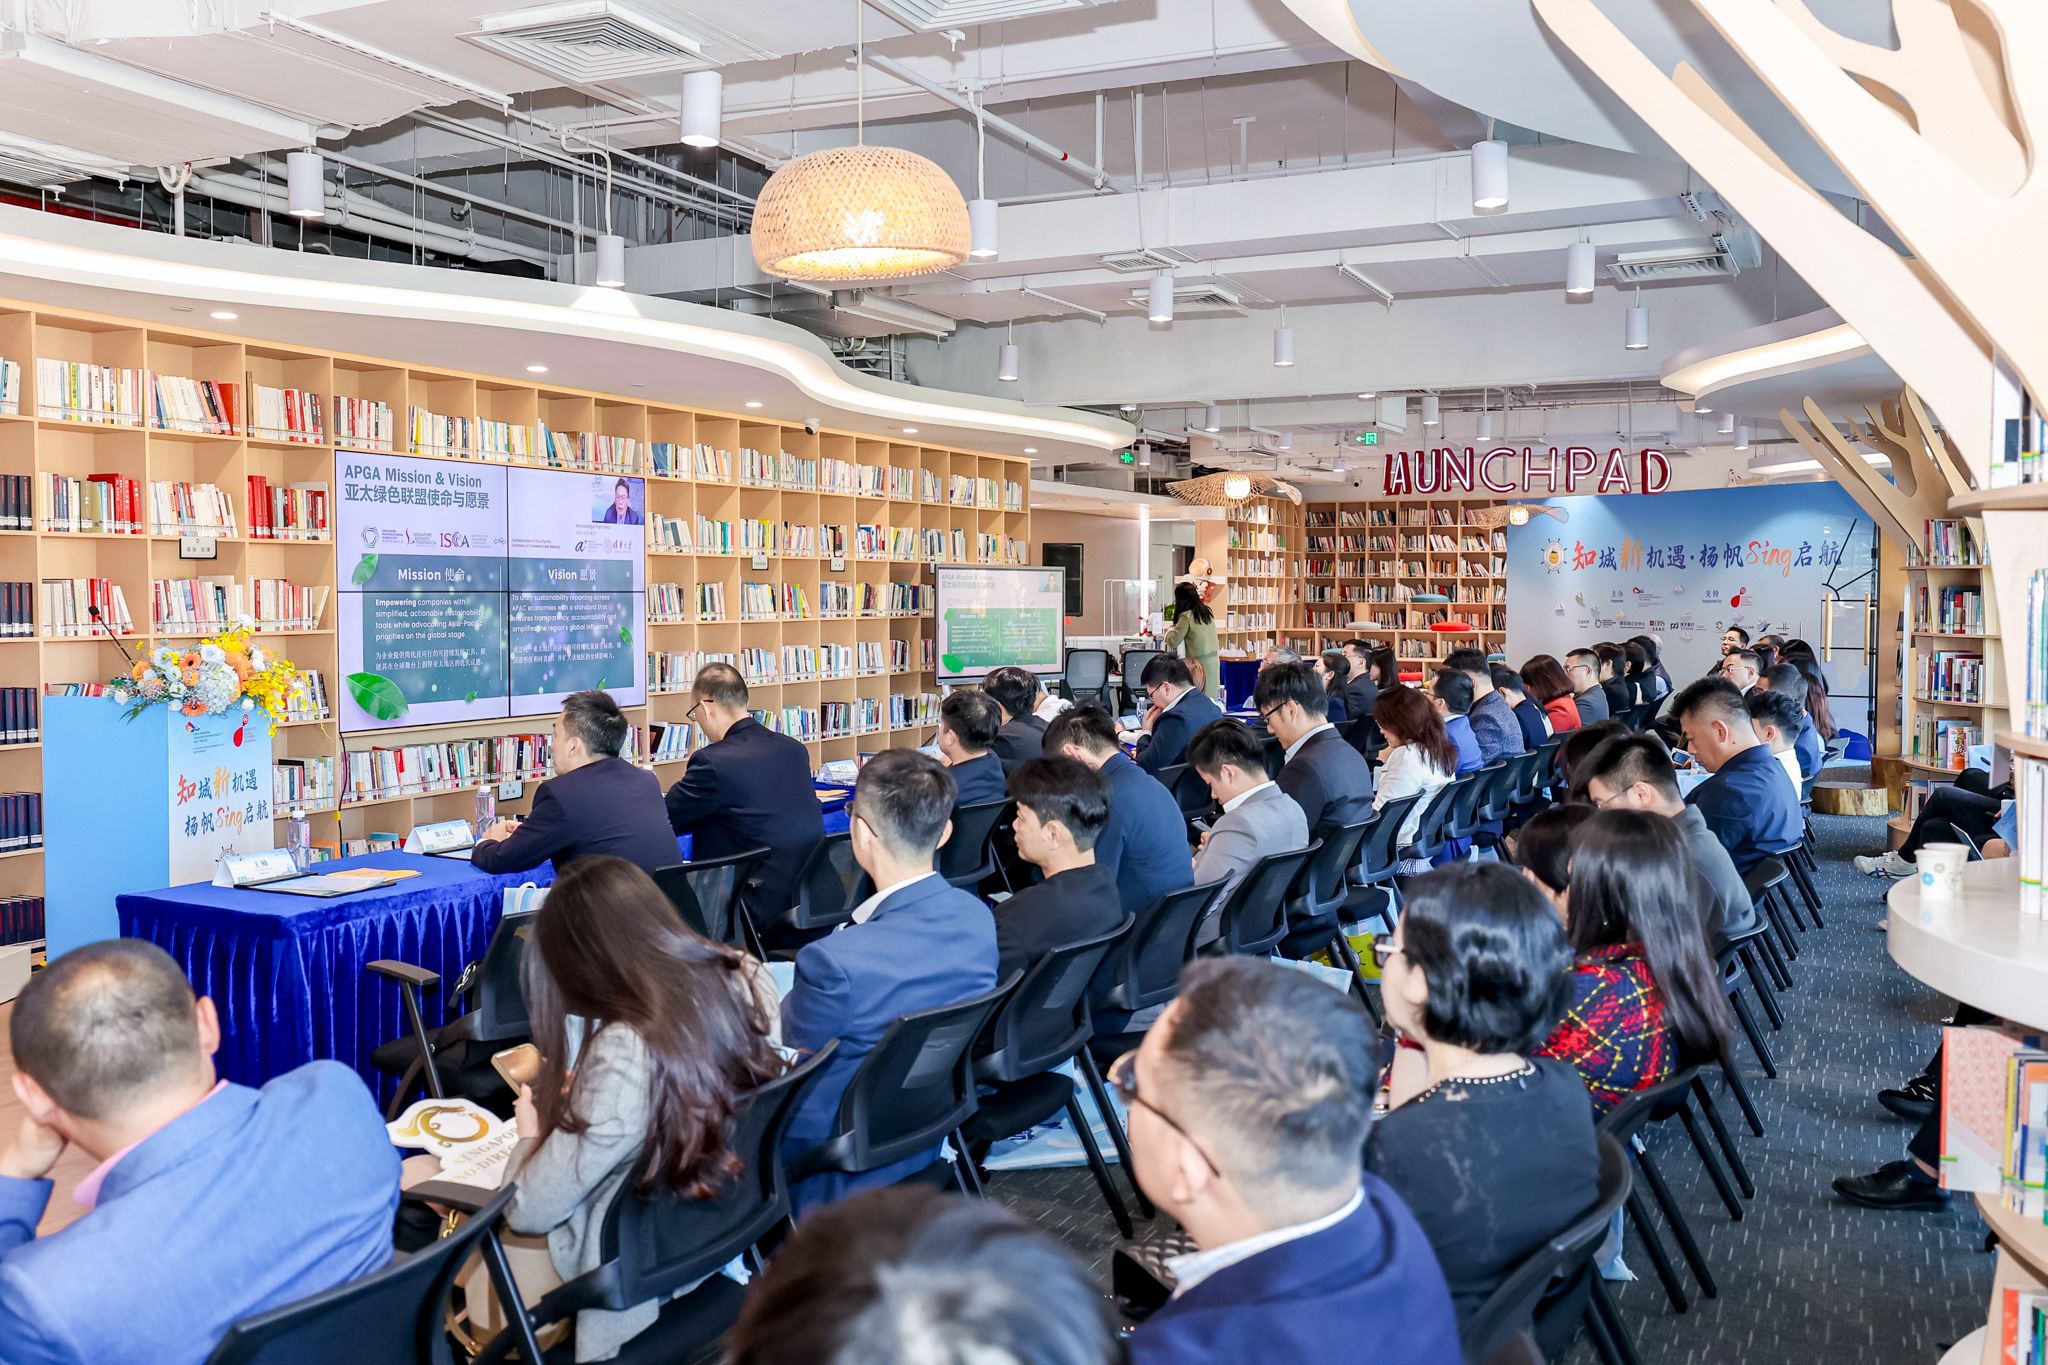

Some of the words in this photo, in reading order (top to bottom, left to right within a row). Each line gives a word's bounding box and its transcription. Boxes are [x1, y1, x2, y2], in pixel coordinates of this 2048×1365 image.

[344, 464, 381, 481] APGA
[385, 467, 432, 484] Mission
[435, 471, 445, 486] &
[448, 472, 482, 488] Vision
[344, 483, 490, 509] 亚太绿色联盟使命与愿景
[398, 568, 441, 581] Mission
[445, 567, 465, 582] 使命
[548, 569, 577, 581] Vision
[375, 598, 417, 608] Empowering
[418, 598, 452, 608] companies
[453, 598, 466, 606] with
[410, 609, 444, 618] actionable
[375, 621, 392, 629] tools
[393, 620, 410, 629] while
[415, 631, 426, 639] the
[427, 631, 447, 641] global
